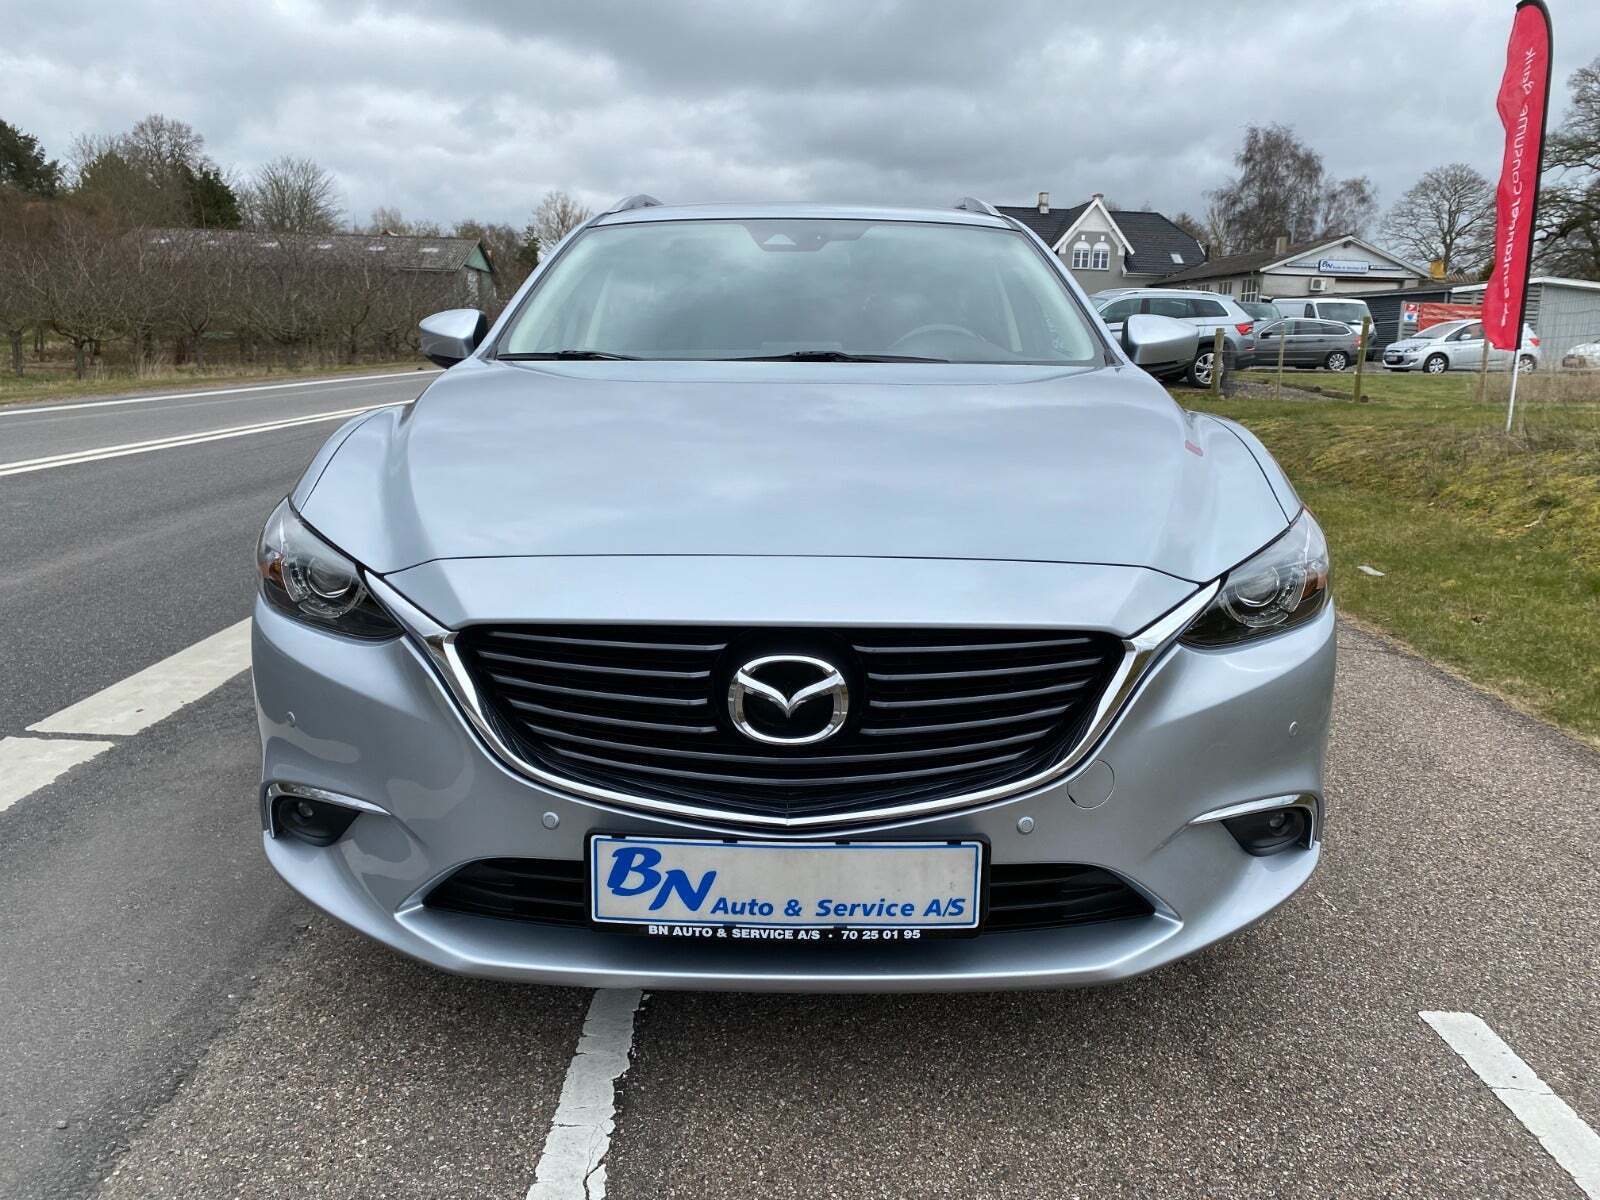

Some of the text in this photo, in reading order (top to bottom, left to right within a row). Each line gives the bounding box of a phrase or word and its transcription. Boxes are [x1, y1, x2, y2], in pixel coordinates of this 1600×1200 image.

[607, 847, 966, 917] BN Auto & Service A/S
[648, 925, 921, 940] BN AUTO & SERVICE A/S 70 25 01 95
